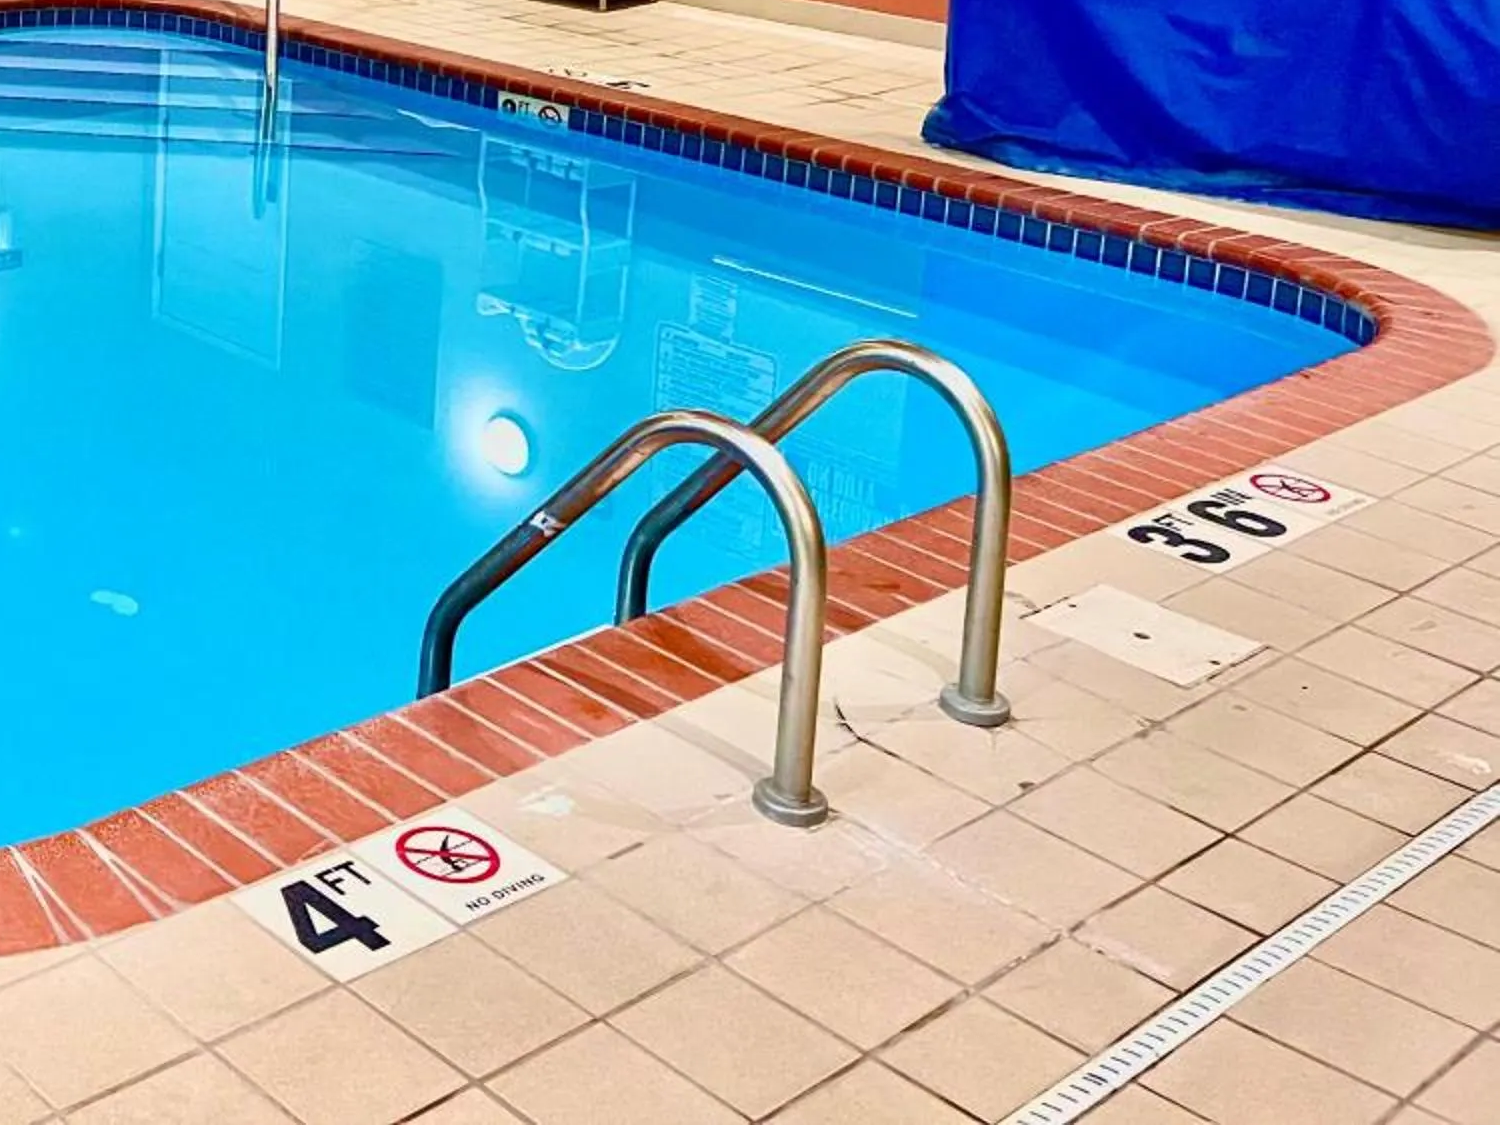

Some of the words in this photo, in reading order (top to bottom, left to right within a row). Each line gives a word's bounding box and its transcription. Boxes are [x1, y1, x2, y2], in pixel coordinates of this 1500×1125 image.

[1127, 525, 1231, 564] 3
[1187, 500, 1288, 538] 6
[314, 861, 372, 895] FT
[465, 896, 491, 911] NO
[491, 873, 546, 900] DIVING
[281, 880, 391, 954] 4
